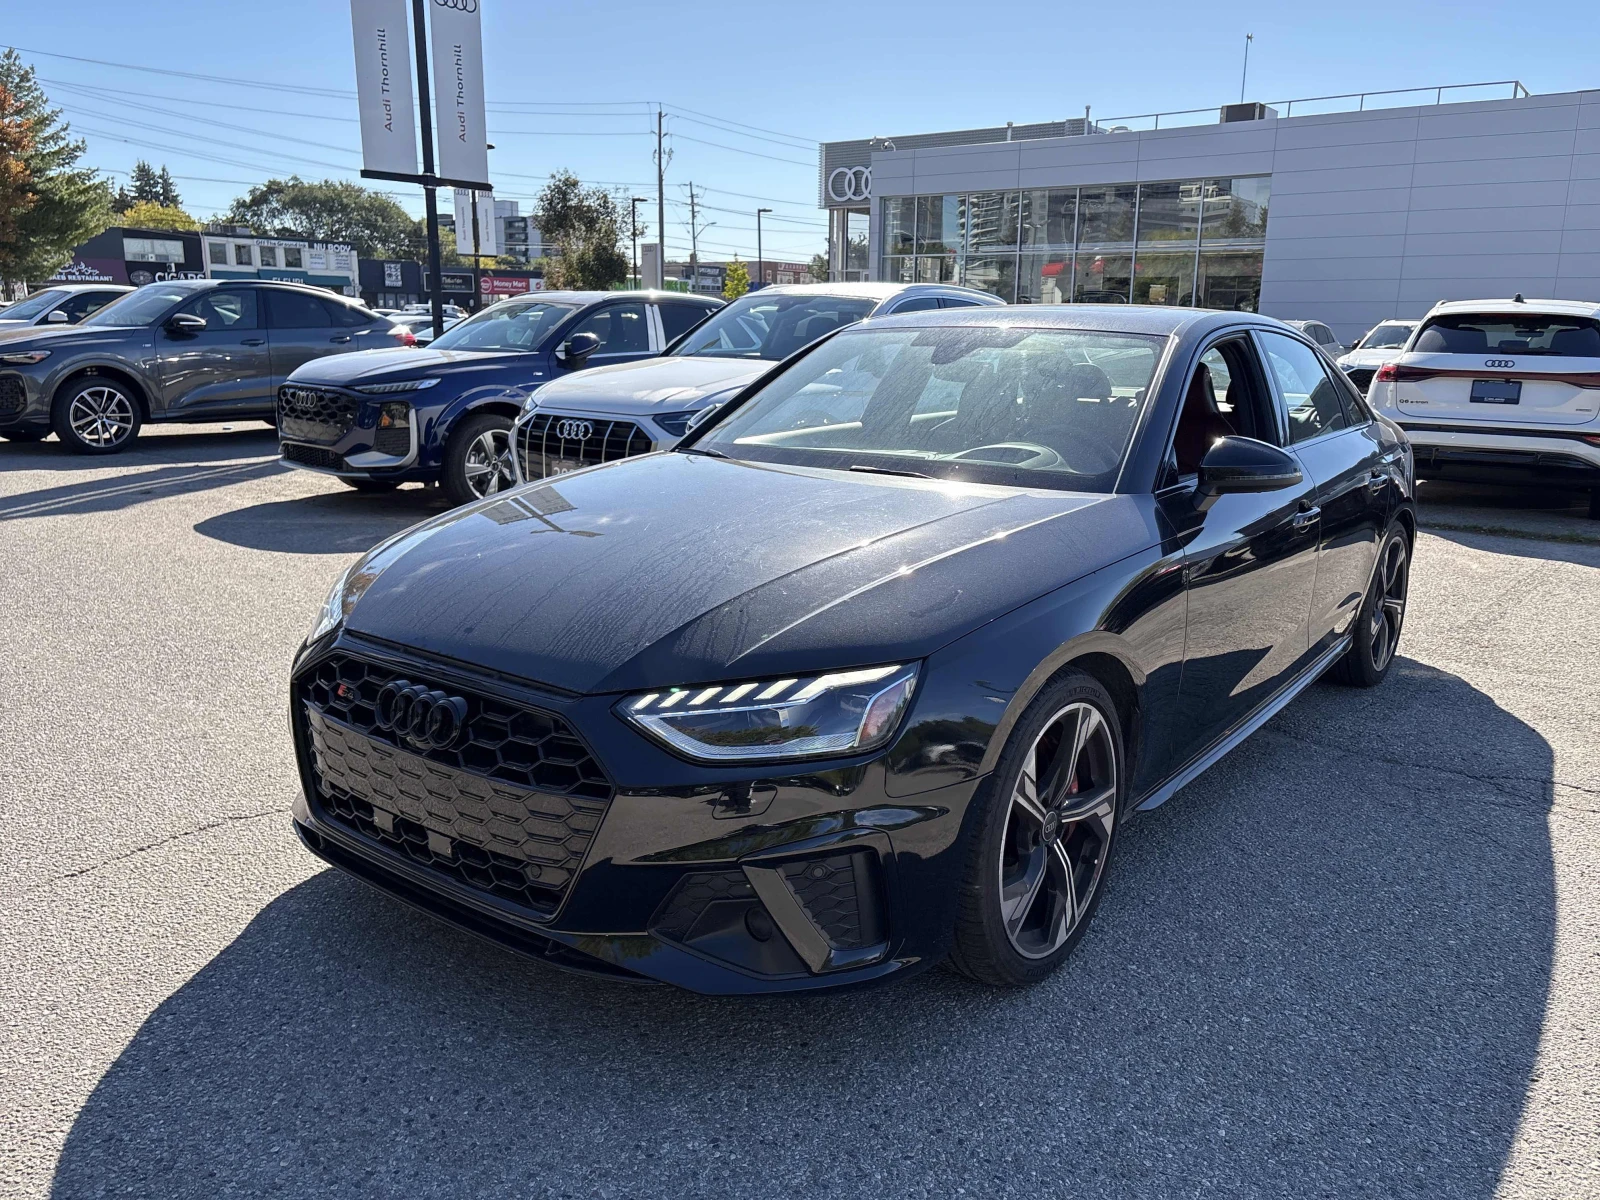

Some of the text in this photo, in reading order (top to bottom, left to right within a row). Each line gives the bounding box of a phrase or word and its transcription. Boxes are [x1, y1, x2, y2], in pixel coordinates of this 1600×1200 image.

[377, 28, 393, 133] Audi Thornhill
[453, 44, 467, 143] Audi Thornhill
[313, 243, 351, 253] NU BODY
[493, 280, 512, 288] Money
[512, 280, 526, 288] Mart
